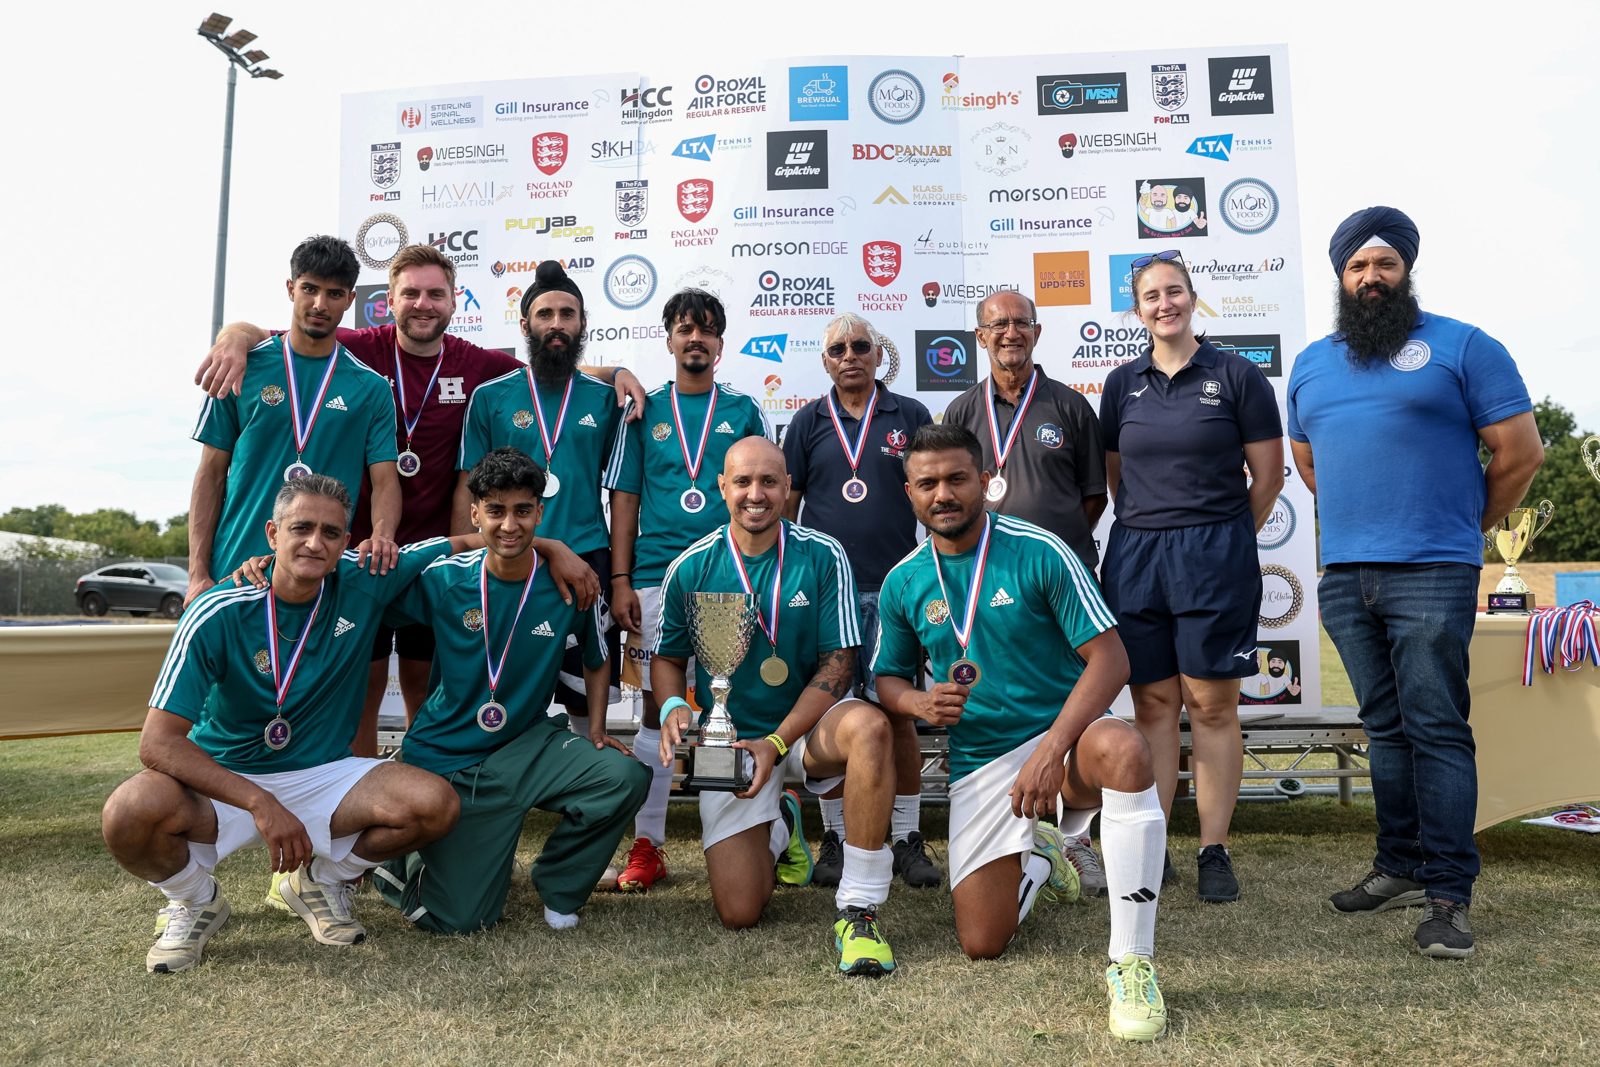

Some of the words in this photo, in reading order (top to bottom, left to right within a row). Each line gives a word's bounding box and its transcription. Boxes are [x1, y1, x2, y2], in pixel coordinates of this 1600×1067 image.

[716, 76, 766, 93] ROYAL
[621, 86, 673, 108] HCC
[1085, 87, 1118, 100] MSN
[1218, 91, 1265, 104] GripActive
[687, 95, 714, 111] AIR
[717, 91, 767, 107] FORCE
[797, 96, 841, 104] BREWSUAL
[430, 102, 472, 111] STERLING
[495, 102, 518, 115] Gill
[522, 100, 589, 114] Insurance
[686, 107, 723, 119] REGULAR
[724, 107, 730, 115] &
[731, 104, 766, 116] RESERVE
[430, 110, 461, 119] SPINAL
[622, 107, 673, 120] Hillingdon
[430, 117, 476, 127] WELLNESS
[717, 137, 752, 145] TENNIS
[1079, 131, 1157, 148] WEBSINGH
[435, 144, 505, 160] WEBSINGH
[681, 143, 713, 156] LTA
[852, 143, 895, 160] BDC
[894, 144, 952, 156] PANJABI
[985, 145, 993, 156] B
[1008, 145, 1018, 155] N
[1196, 140, 1230, 155] LTA
[897, 154, 940, 166] Magazine
[774, 165, 821, 178] GripActive
[526, 180, 573, 191] ENGLAND
[912, 185, 944, 193] KLASS
[530, 189, 569, 200] HOCKEY
[912, 193, 968, 202] MARQUEES
[989, 186, 1068, 204] morson
[1070, 185, 1107, 200] EDGE
[421, 199, 494, 210] IMMIGRATION
[733, 206, 757, 220] Gill
[762, 206, 834, 219] Insurance
[1236, 211, 1264, 219] FOODS
[989, 218, 1015, 232] Gill
[1018, 216, 1093, 231] Insurance
[551, 225, 594, 239] 2000
[670, 227, 719, 239] ENGLAND
[428, 229, 479, 252] HCC
[573, 235, 594, 244] .com
[674, 237, 715, 248] HOCKEY
[731, 241, 810, 258] morson
[812, 241, 849, 255] EDGE
[1258, 257, 1285, 272] Aid
[1040, 271, 1054, 281] UK
[1211, 274, 1231, 282] Better
[1231, 273, 1260, 282] Together
[782, 277, 835, 291] ROYAL
[618, 287, 643, 295] FOODS
[750, 293, 780, 308] AIR
[782, 292, 835, 307] FORCE
[858, 293, 908, 302] ENGLAND
[1221, 296, 1254, 304] KLASS
[750, 308, 789, 317] REGULAR
[798, 307, 835, 316] RESERVE
[862, 302, 905, 311] HOCKEY
[1221, 303, 1280, 313] MARQUEES
[1104, 327, 1149, 342] ROYA
[751, 340, 784, 356] LTA
[1072, 344, 1103, 359] AIR
[1071, 360, 1112, 369] REGULAR
[438, 376, 466, 400] H
[325, 402, 348, 412] adidas
[578, 420, 598, 428] adidas
[788, 599, 810, 608] adidas
[989, 598, 1014, 608] adidas
[333, 622, 356, 638] adidas
[531, 628, 555, 637] adidas
